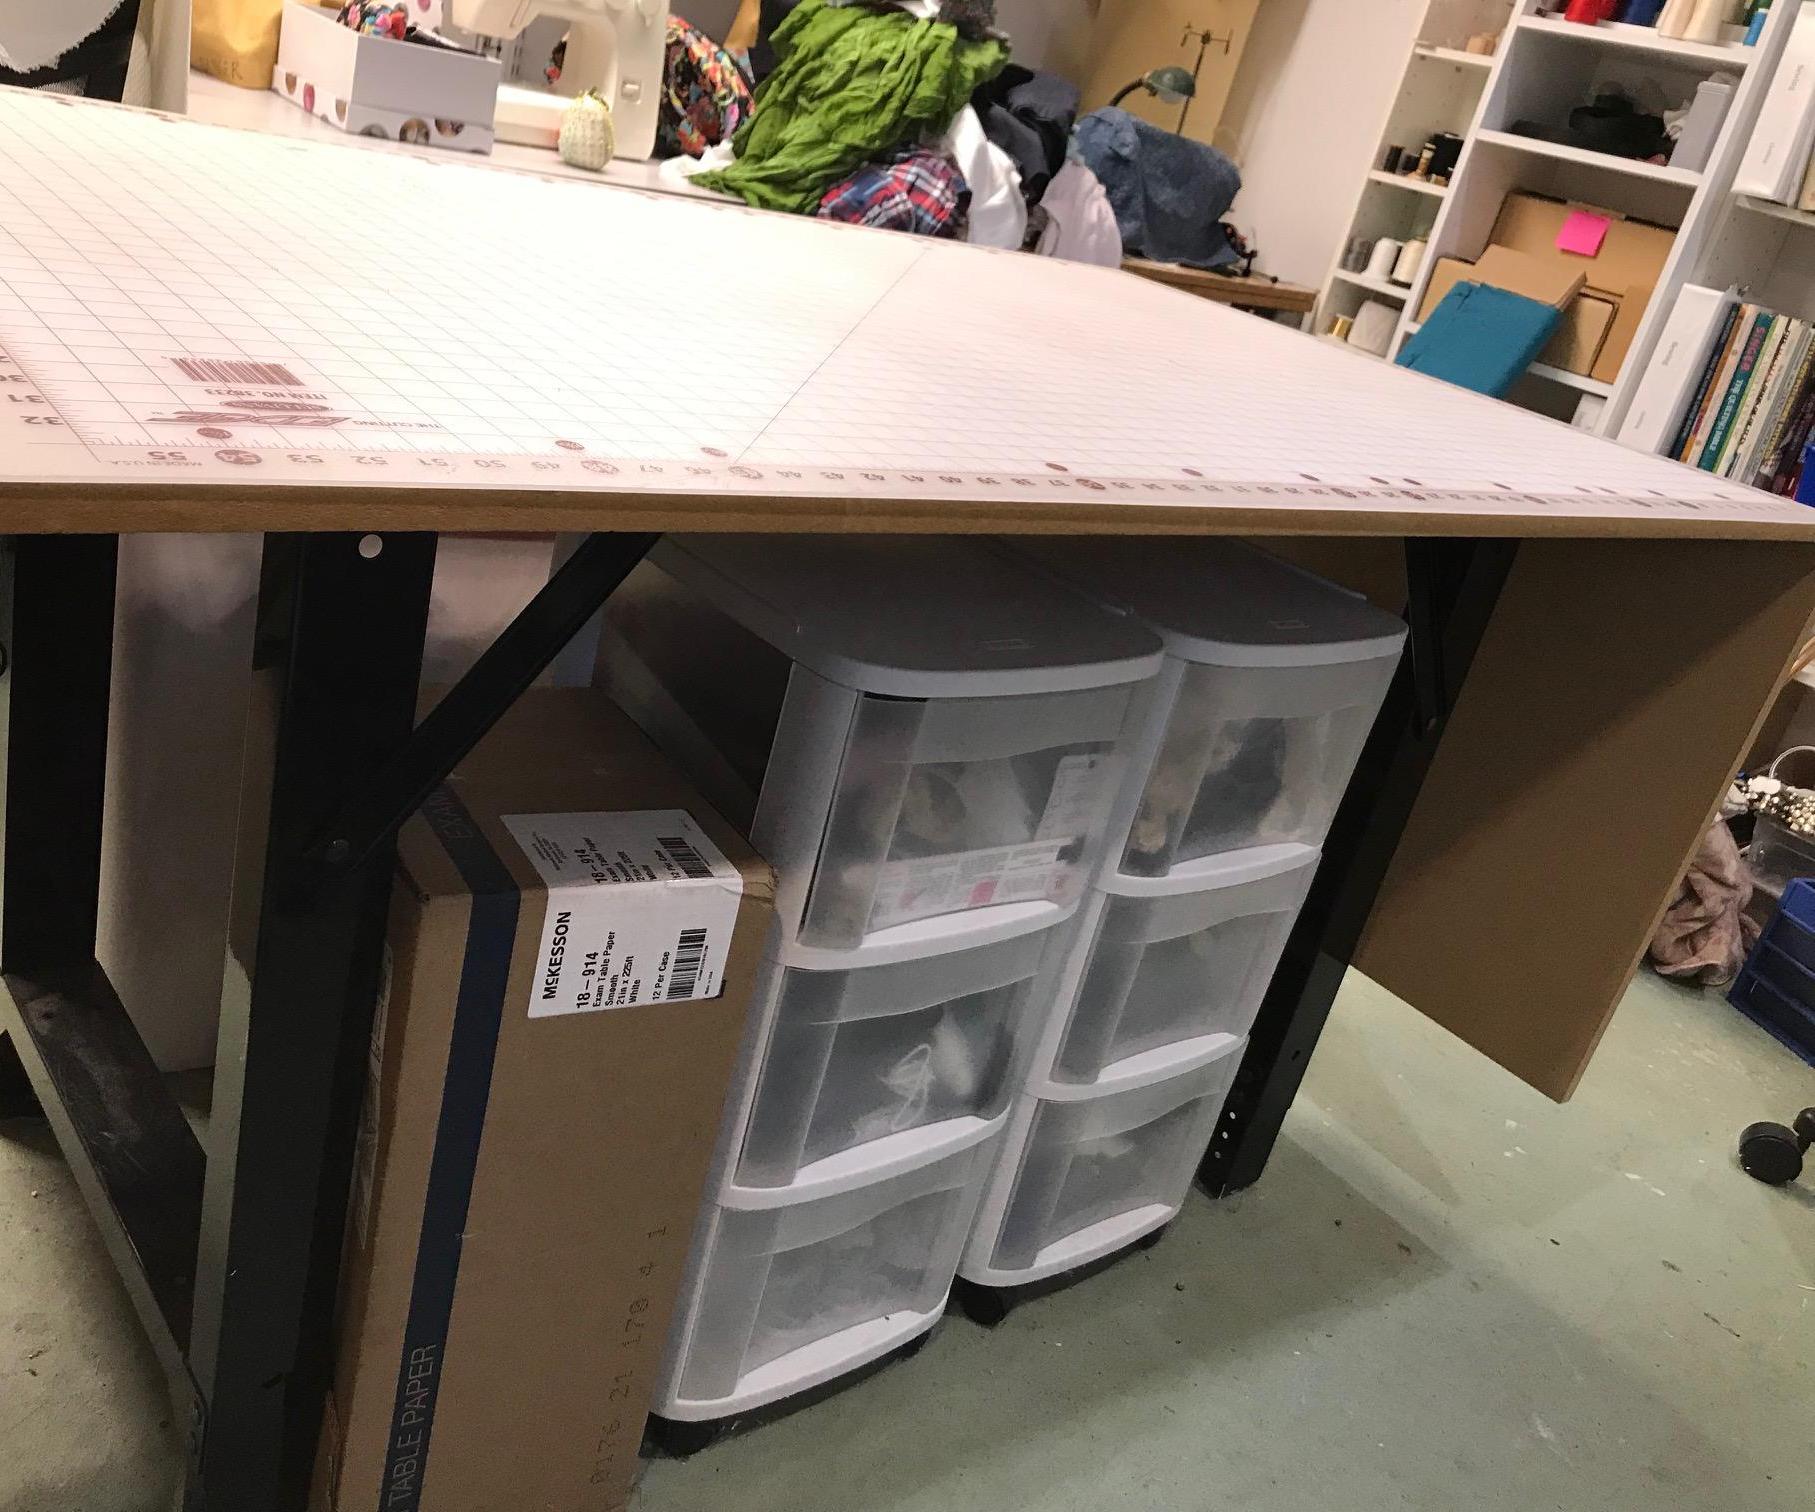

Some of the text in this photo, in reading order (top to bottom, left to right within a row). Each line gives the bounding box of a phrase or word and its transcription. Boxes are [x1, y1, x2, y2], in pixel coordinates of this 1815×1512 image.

[1741, 326, 1766, 372] SINGER
[20, 415, 65, 425] 32
[150, 451, 188, 461] 55
[287, 454, 325, 464] 53
[350, 455, 389, 466] 52
[416, 457, 449, 467] 51
[472, 459, 506, 469] 50
[592, 931, 615, 1007] Exam Table Paper
[658, 951, 670, 972] Case
[605, 974, 619, 1006] Smooth
[654, 974, 665, 989] Per
[616, 986, 628, 1005] 21in
[628, 979, 641, 1004] White
[388, 1343, 437, 1507] TABLE PAPER
